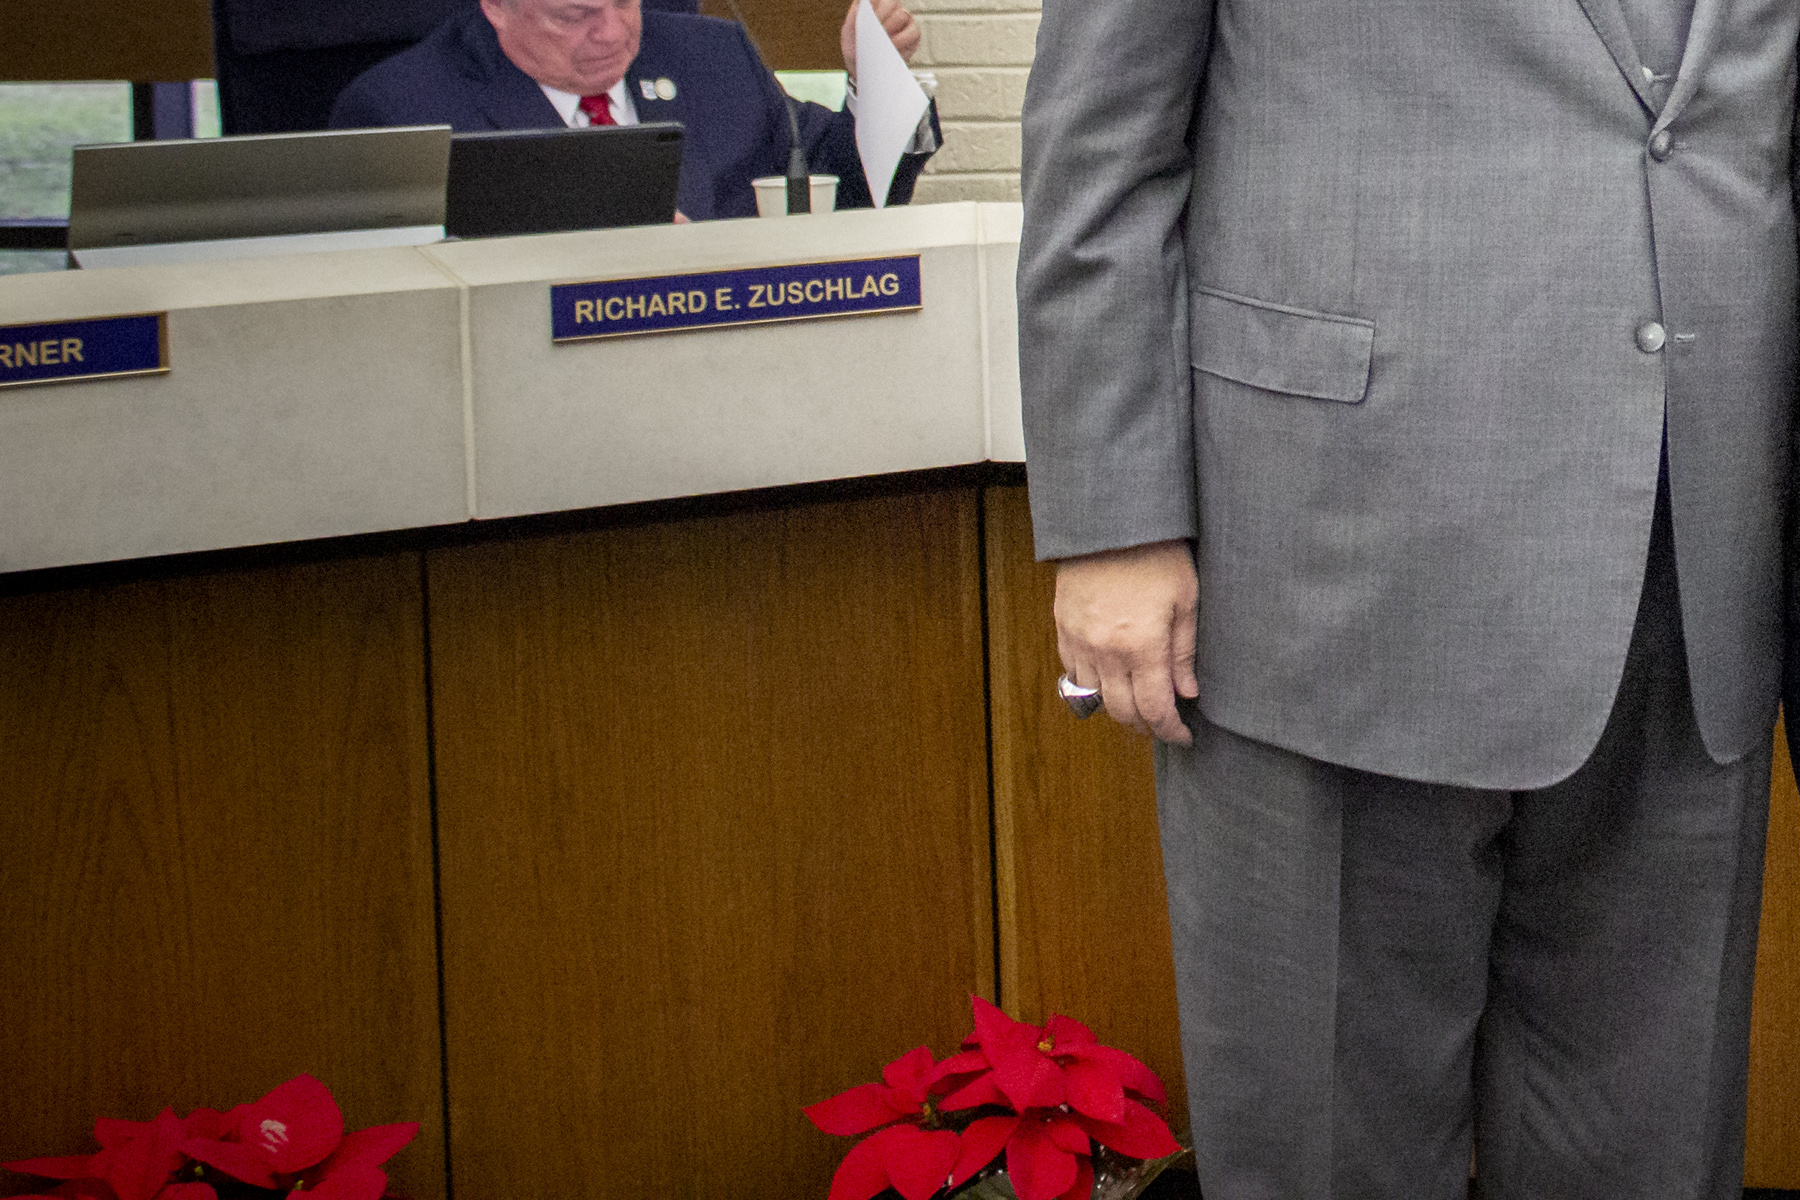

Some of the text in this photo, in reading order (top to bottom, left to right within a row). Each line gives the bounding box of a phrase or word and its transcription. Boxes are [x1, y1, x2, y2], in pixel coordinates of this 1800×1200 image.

[574, 273, 900, 324] RICHARD E. ZUSCHLAG
